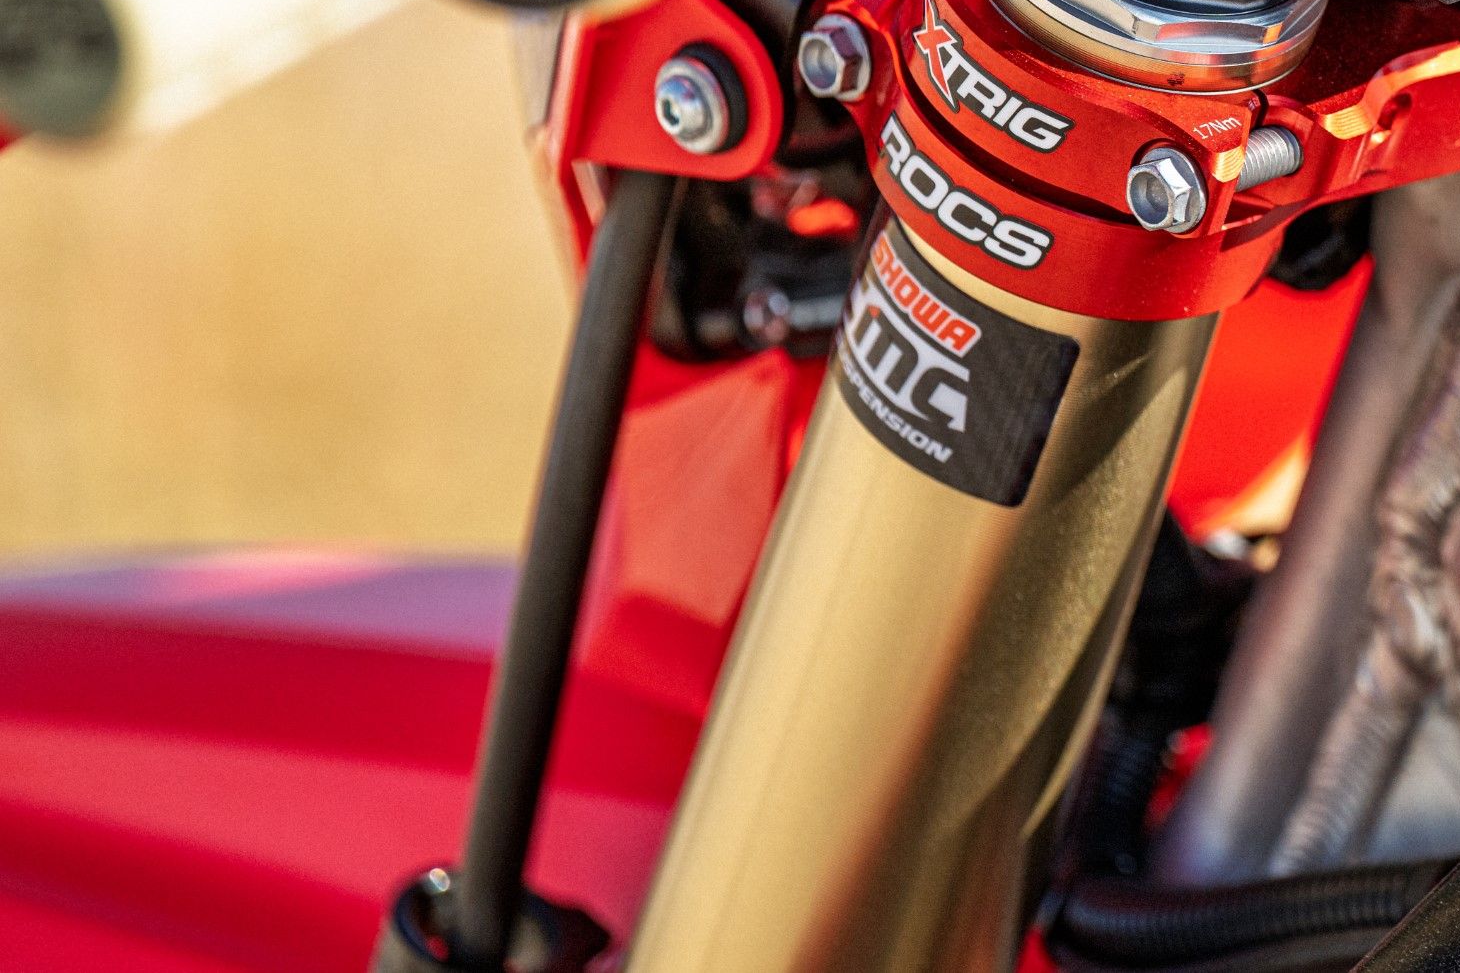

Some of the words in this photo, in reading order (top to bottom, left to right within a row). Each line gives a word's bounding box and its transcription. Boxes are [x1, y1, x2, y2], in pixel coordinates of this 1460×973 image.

[879, 113, 1051, 267] ROCS
[1192, 117, 1242, 140] 17Nm
[870, 232, 981, 358] SHOWA
[838, 334, 953, 464] SPENSION
